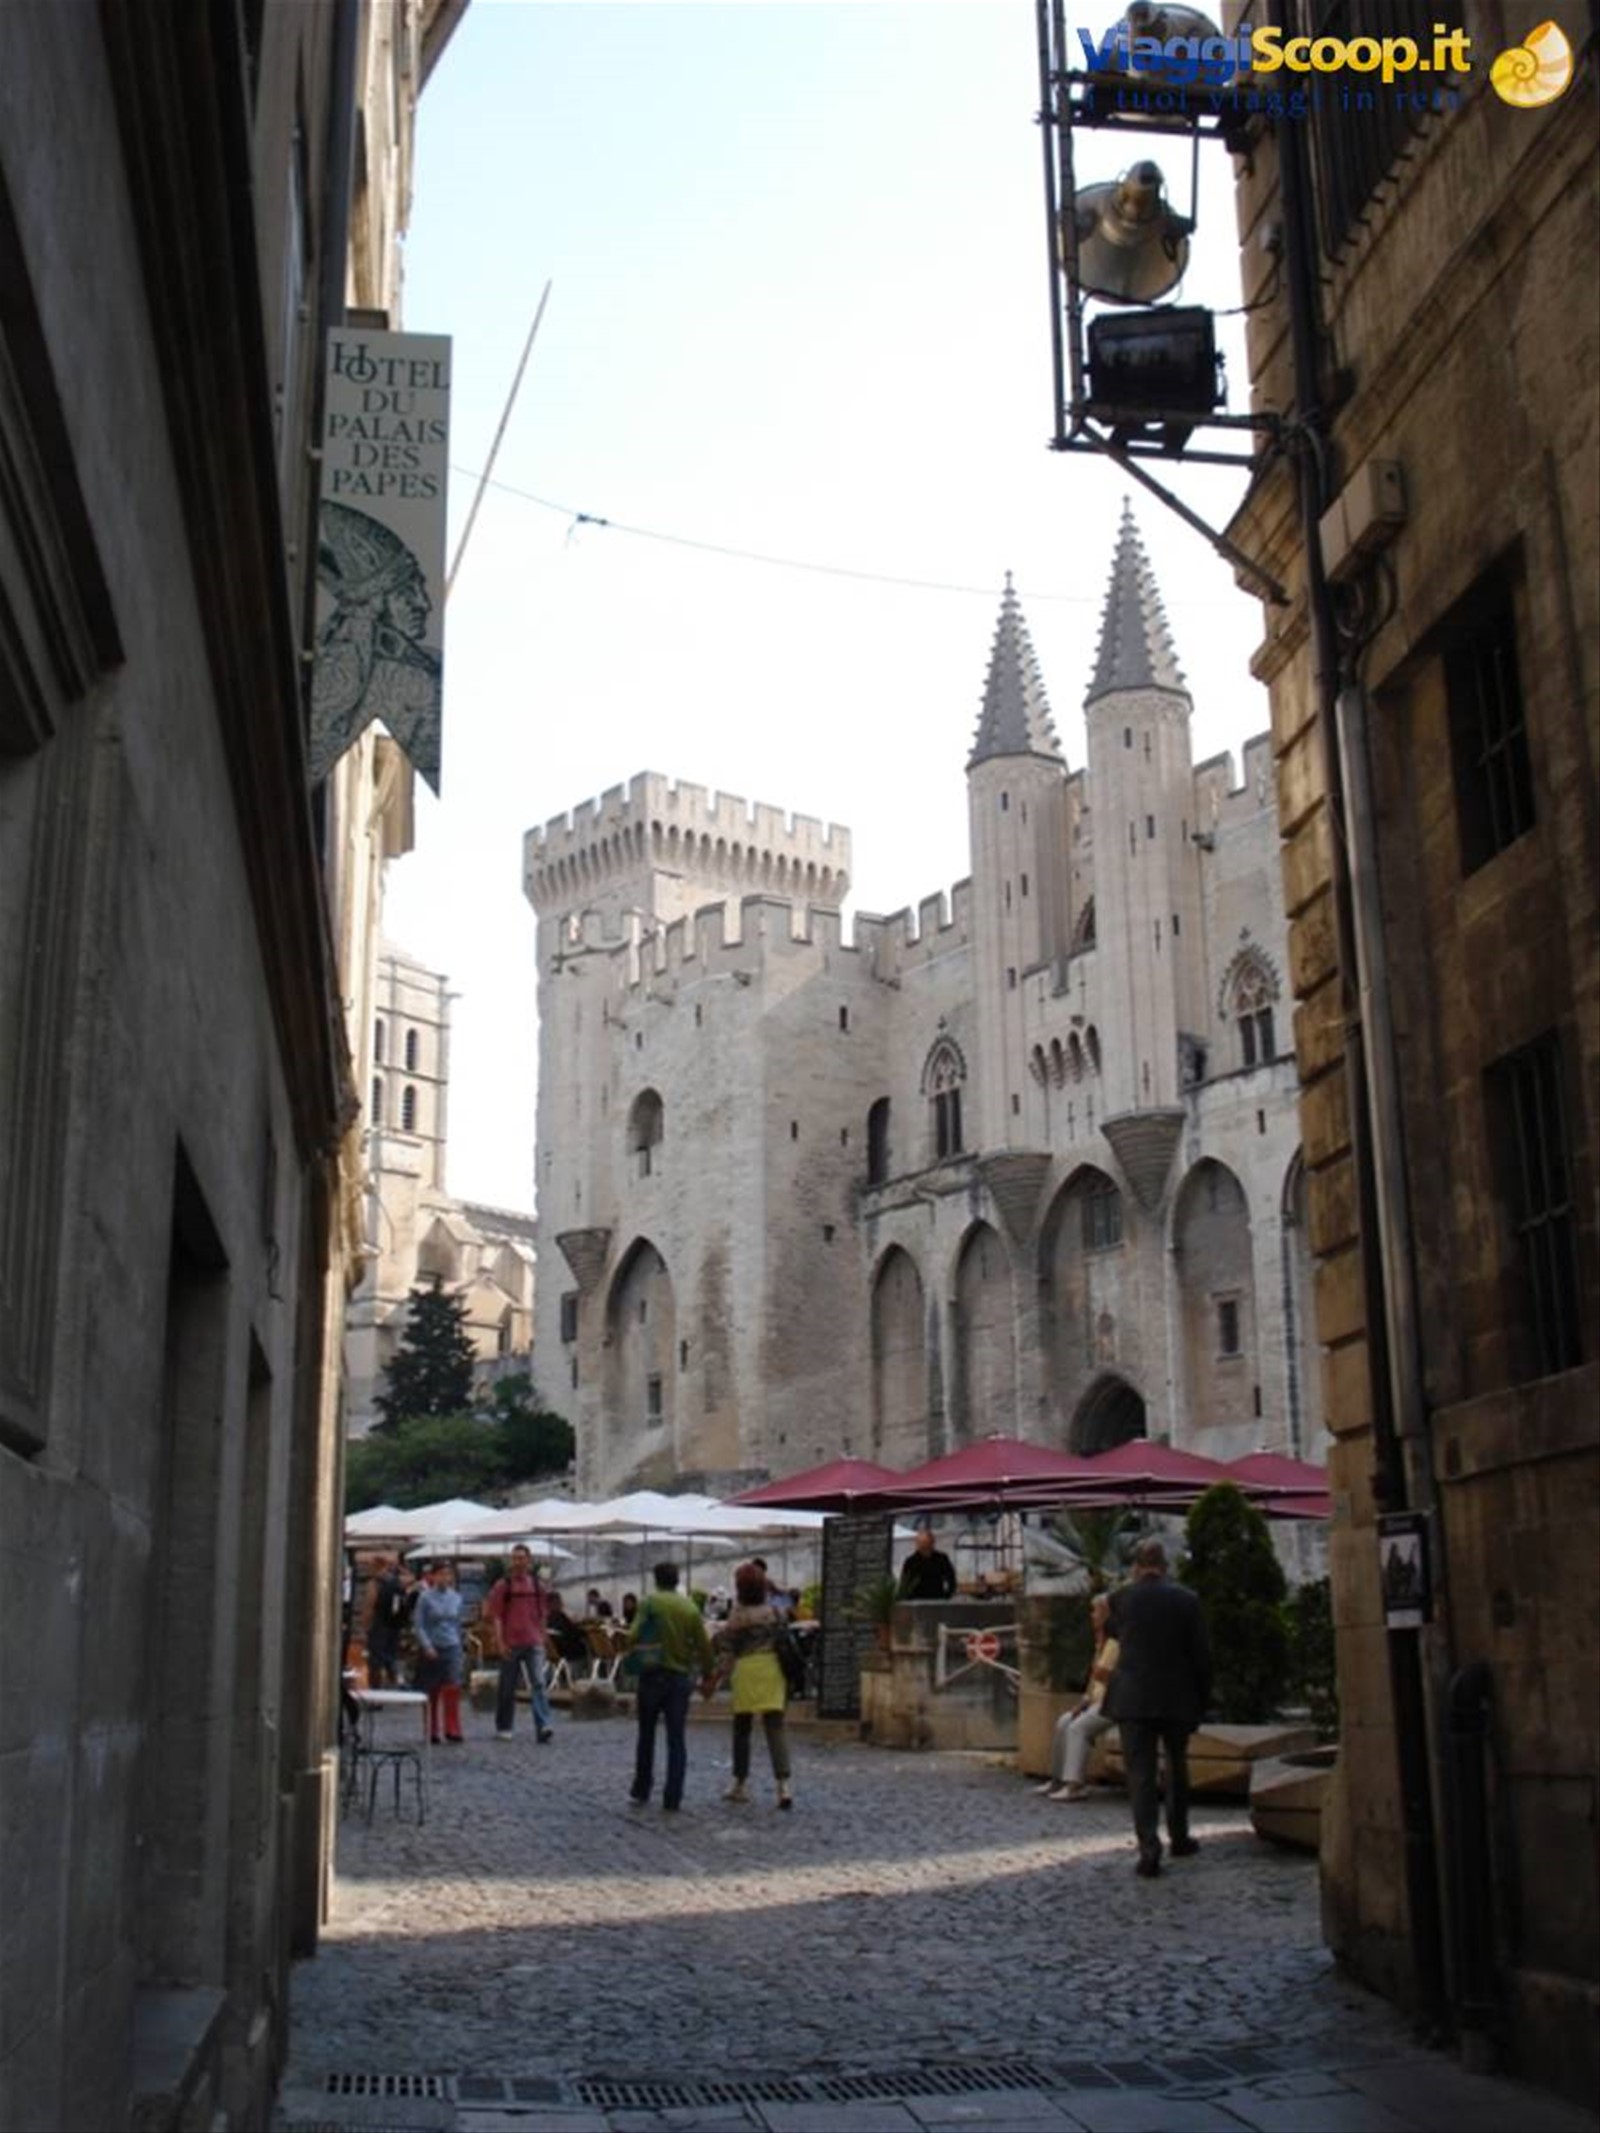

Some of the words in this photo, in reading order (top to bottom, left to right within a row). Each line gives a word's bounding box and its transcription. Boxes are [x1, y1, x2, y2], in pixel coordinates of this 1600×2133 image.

[363, 389, 416, 414] DU
[329, 414, 447, 444] PALAIS
[352, 443, 420, 470] DES
[332, 470, 439, 498] PAPES
